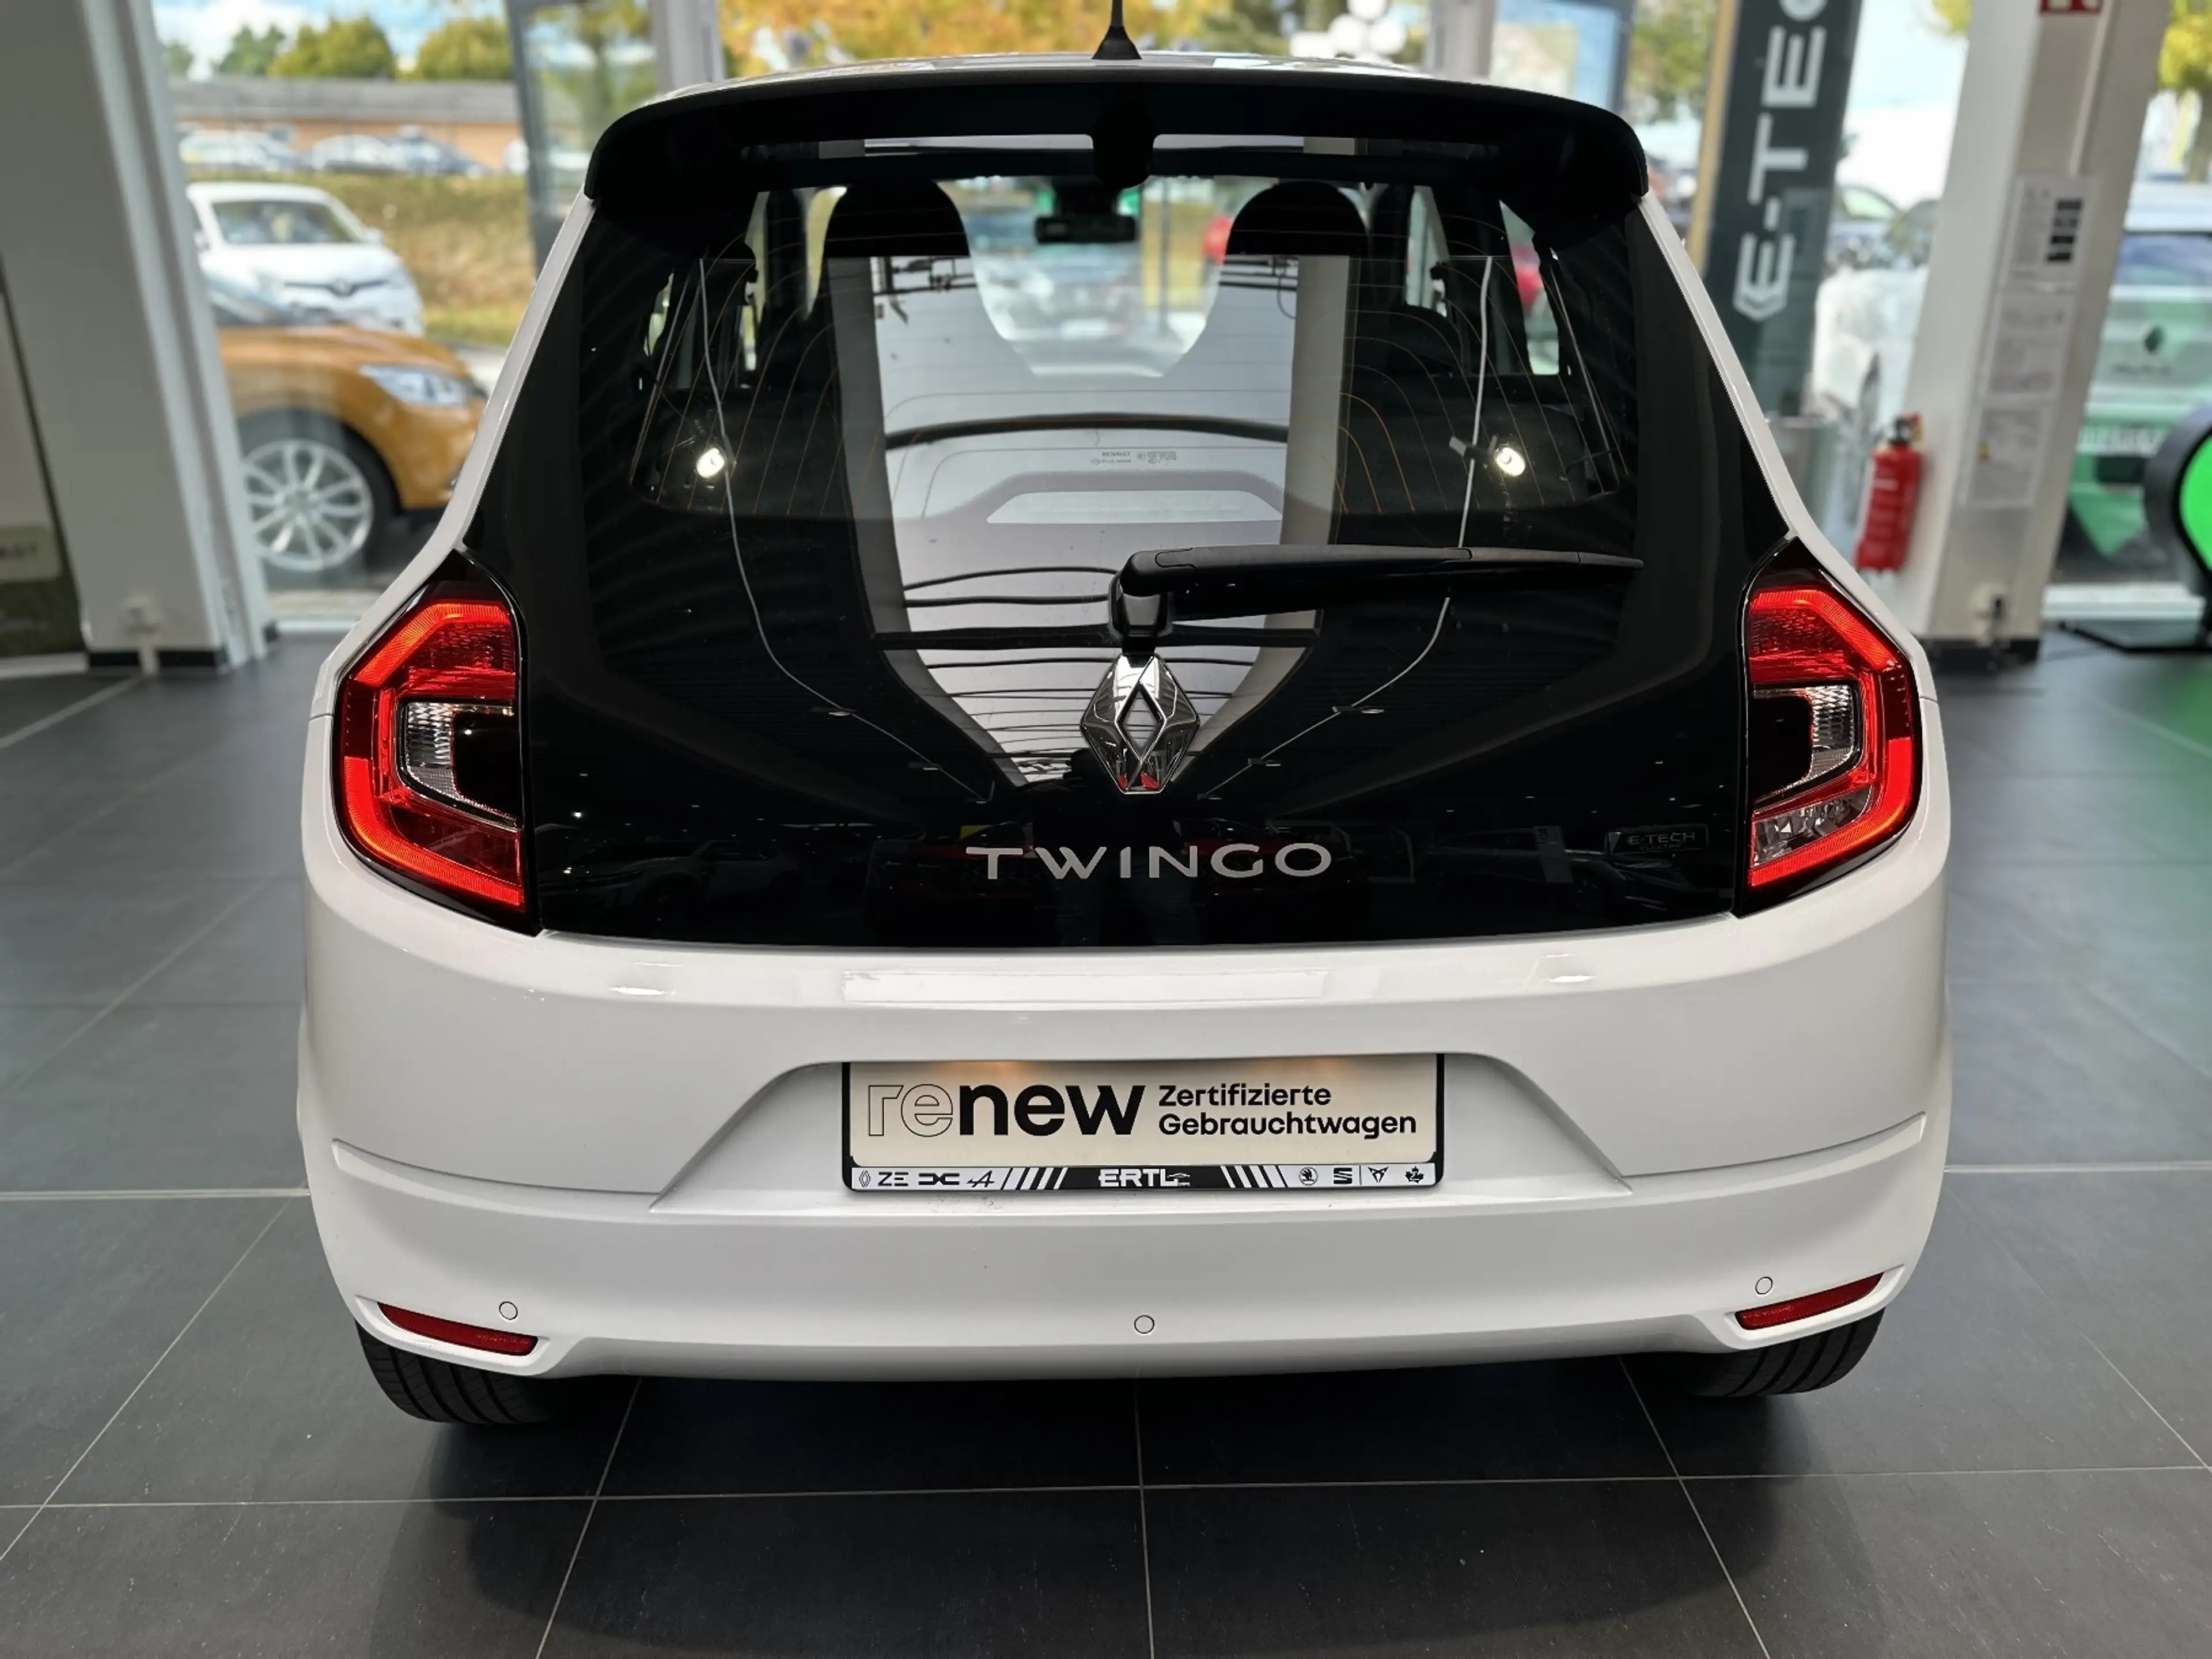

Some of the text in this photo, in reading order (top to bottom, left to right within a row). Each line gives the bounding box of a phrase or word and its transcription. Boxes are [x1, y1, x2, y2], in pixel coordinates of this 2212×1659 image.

[1732, 0, 1827, 322] E-TE
[1627, 832, 1695, 846] E-TECH
[965, 842, 1332, 880] TWINGO
[1158, 1083, 1332, 1107] Zertifizierte
[868, 1084, 1146, 1137] renew
[1158, 1111, 1417, 1140] Gebrauchtwagen
[1099, 1168, 1179, 1187] ERTL
